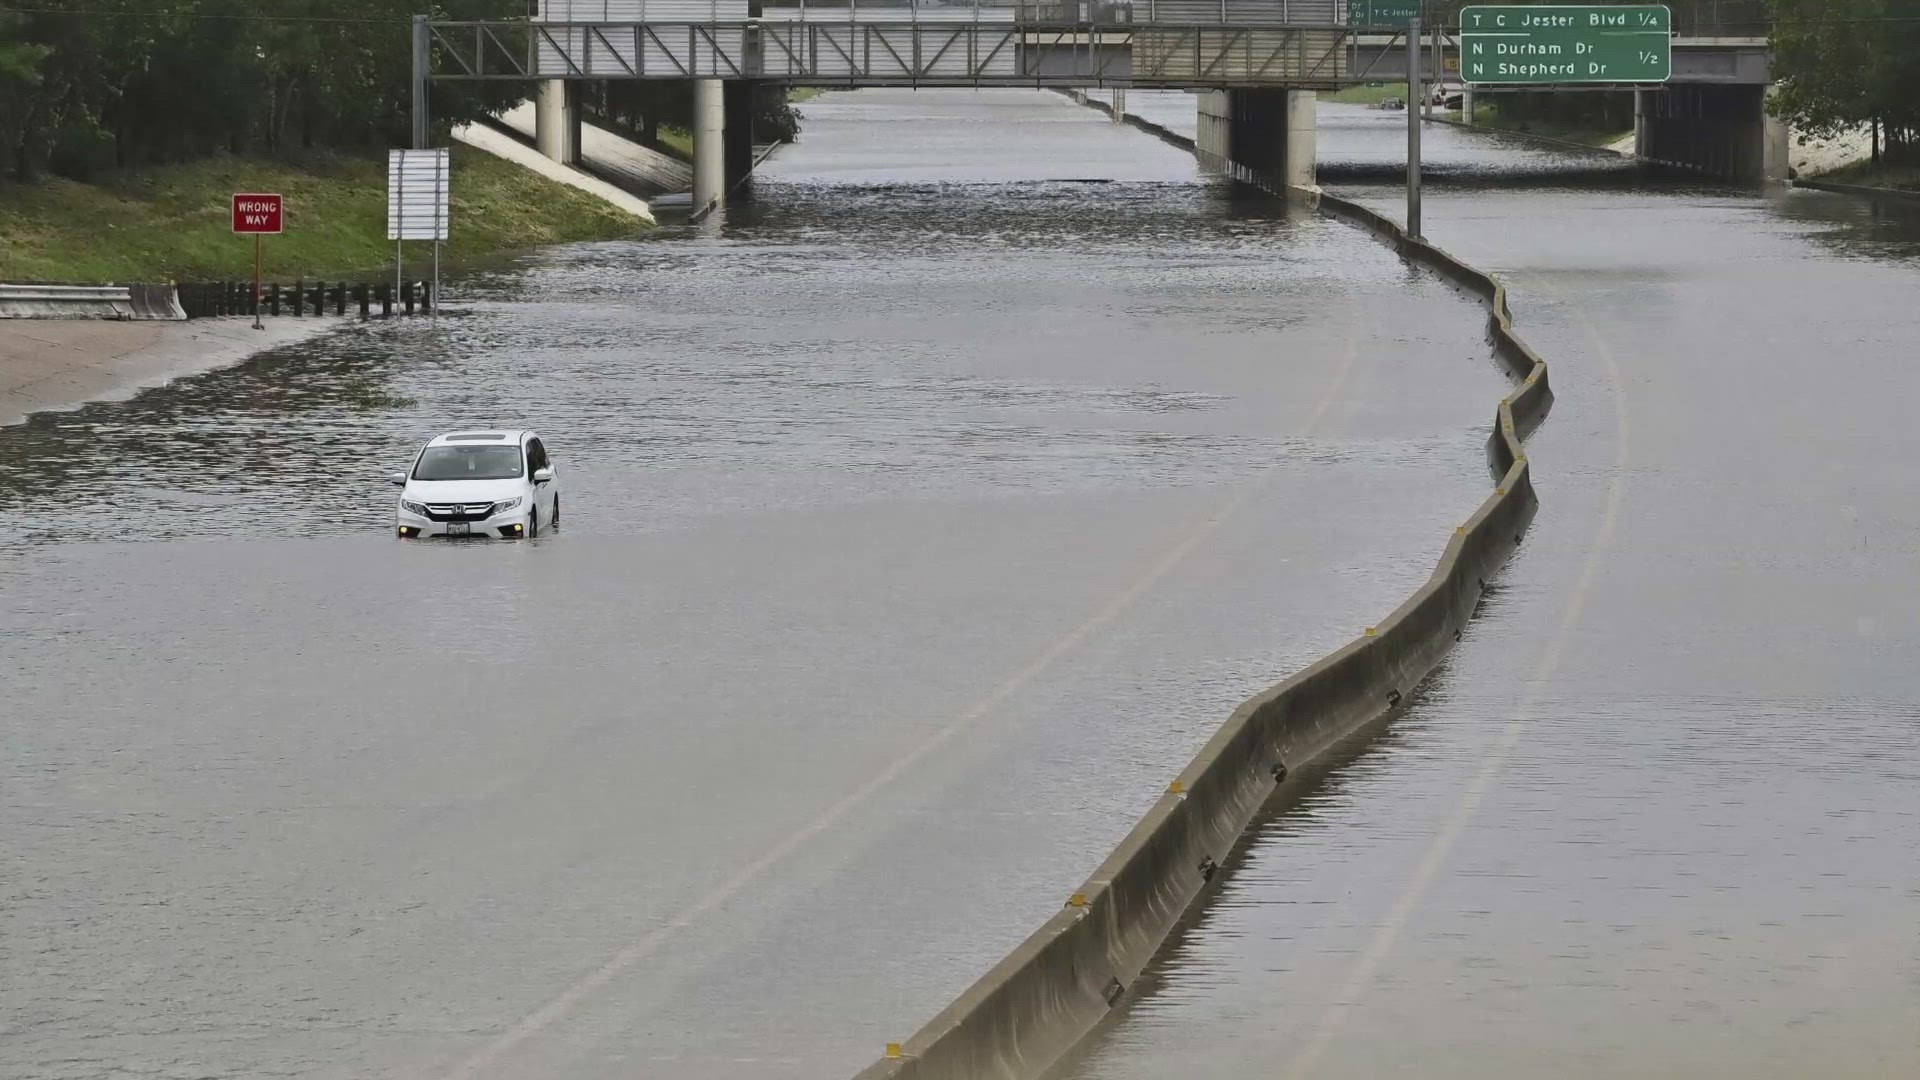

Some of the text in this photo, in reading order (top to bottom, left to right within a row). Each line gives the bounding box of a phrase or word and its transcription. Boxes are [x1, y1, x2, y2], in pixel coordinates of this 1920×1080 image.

[1473, 12, 1658, 26] T C Jester Blvd 1/4
[1473, 43, 1594, 54] N Durham Dr
[1639, 52, 1658, 64] 1/2
[1473, 62, 1606, 76] N Shepherd Dr
[238, 202, 276, 212] WRONG
[246, 215, 268, 225] WAY
